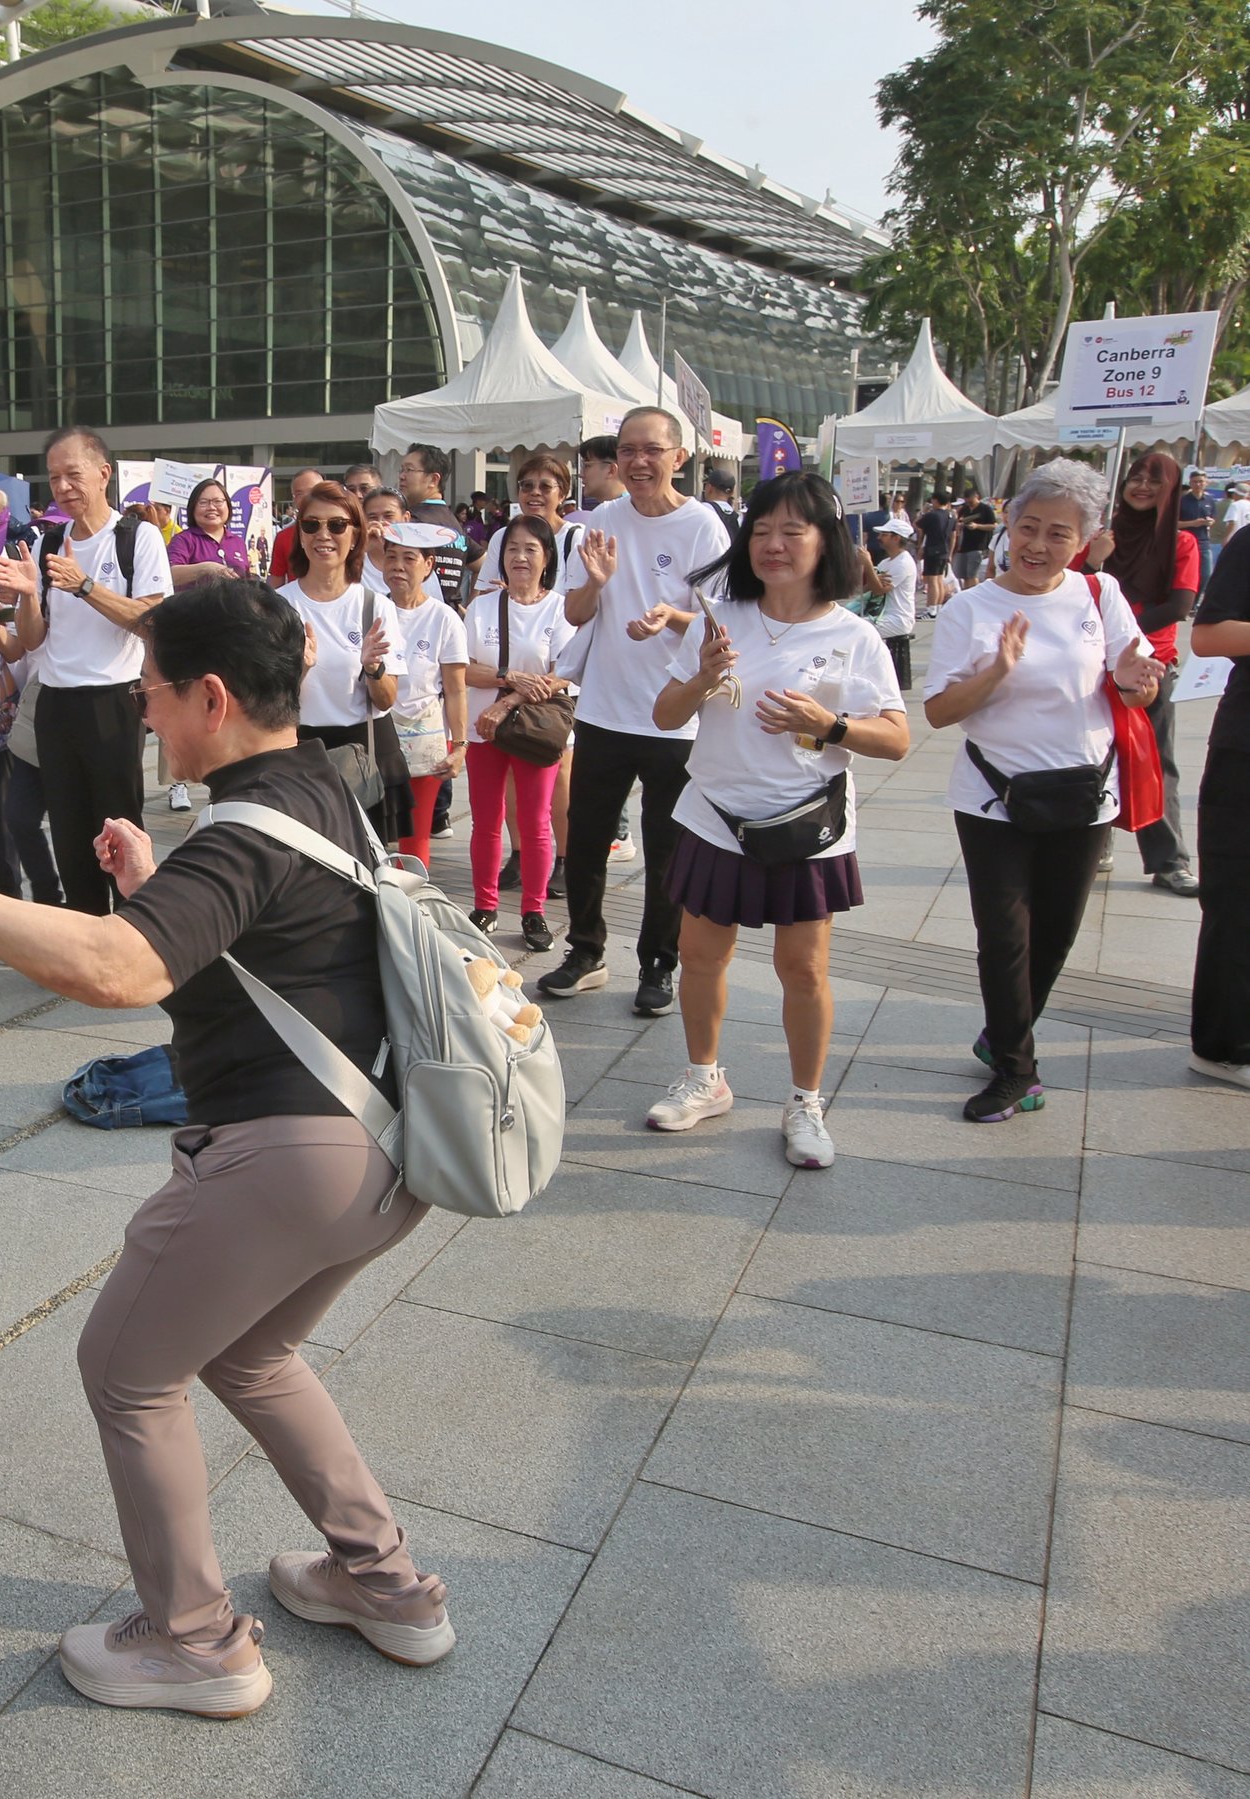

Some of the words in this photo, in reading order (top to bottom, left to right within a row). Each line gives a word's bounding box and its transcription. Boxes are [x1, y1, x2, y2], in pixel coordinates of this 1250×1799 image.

[1096, 347, 1176, 363] Canberra
[1102, 369, 1146, 383] Zone
[1151, 366, 1162, 380] 9
[1106, 387, 1134, 399] Bus
[1139, 385, 1156, 397] 12
[171, 480, 187, 489] Zone
